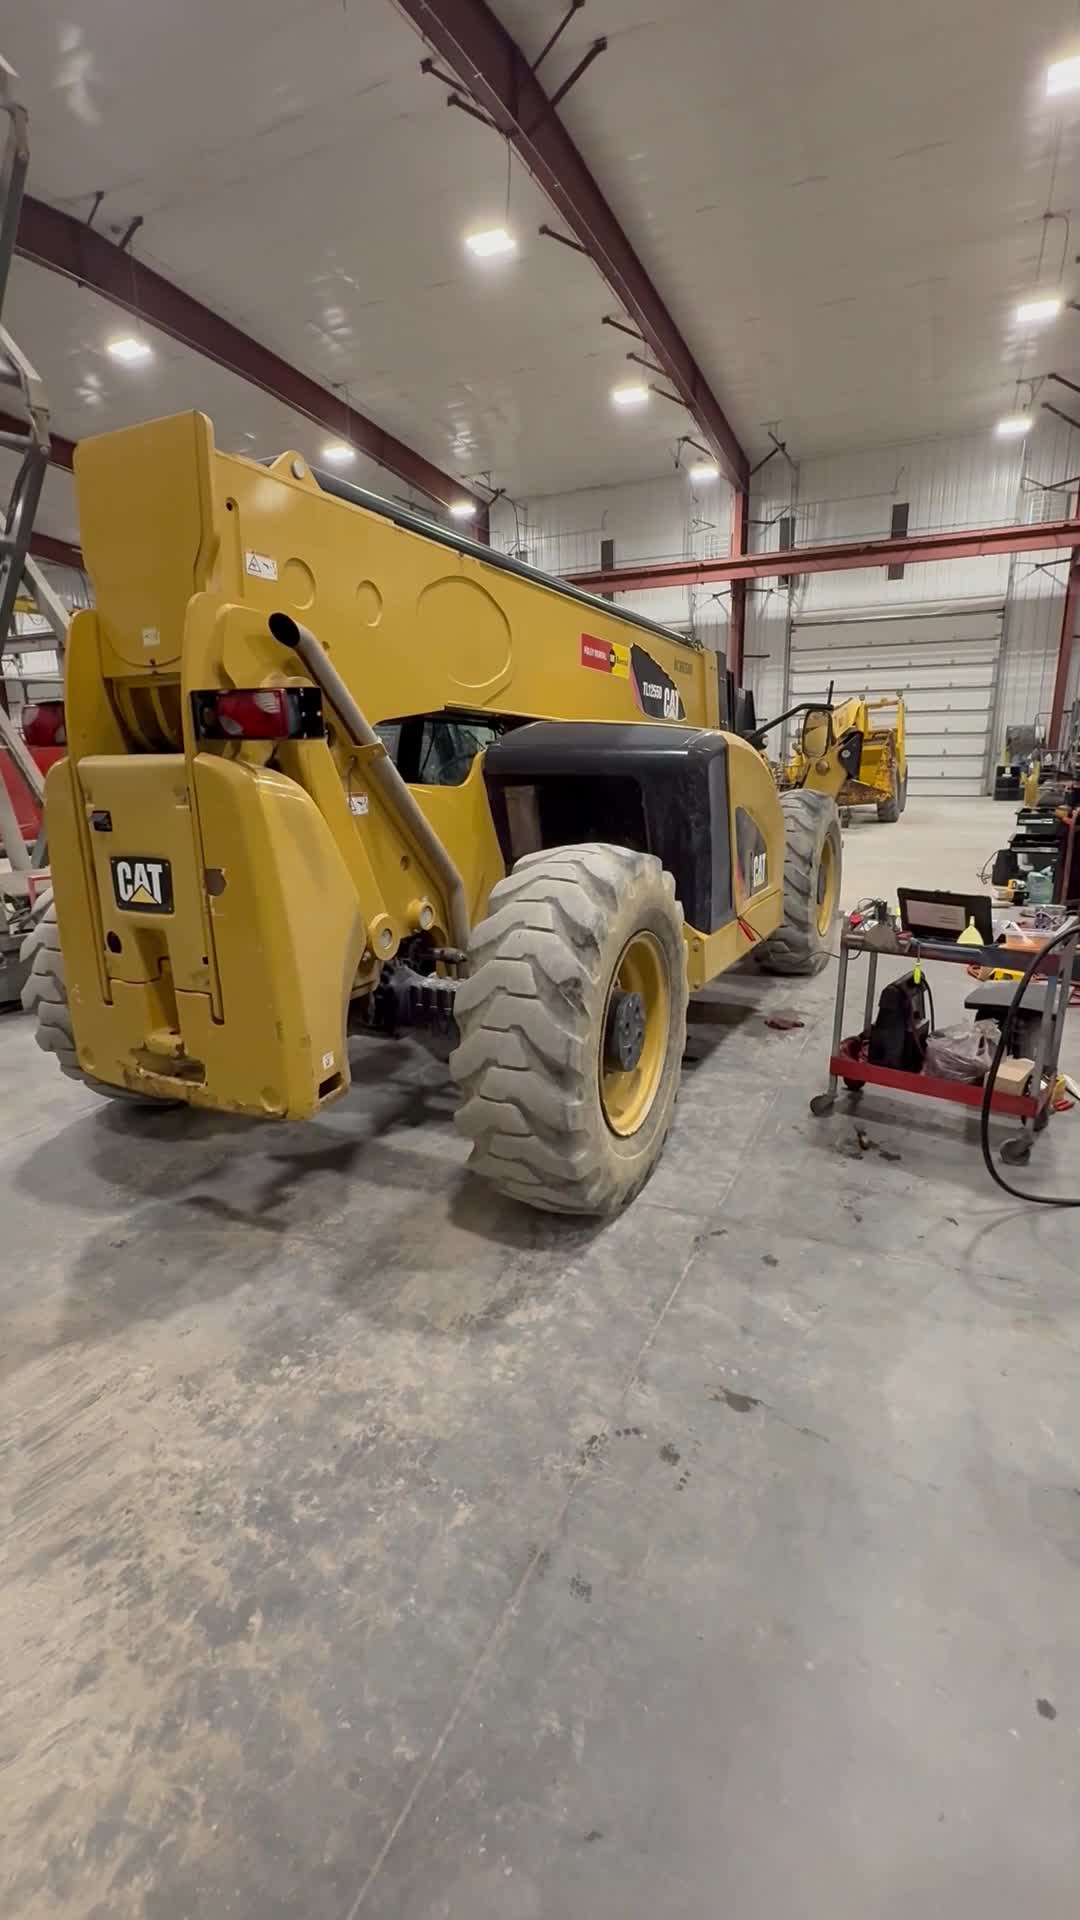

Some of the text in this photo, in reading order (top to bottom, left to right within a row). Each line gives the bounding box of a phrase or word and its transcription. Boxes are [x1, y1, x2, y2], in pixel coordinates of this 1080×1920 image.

[664, 687, 679, 720] CAT
[116, 861, 163, 905] CAT
[753, 852, 767, 888] CAT
